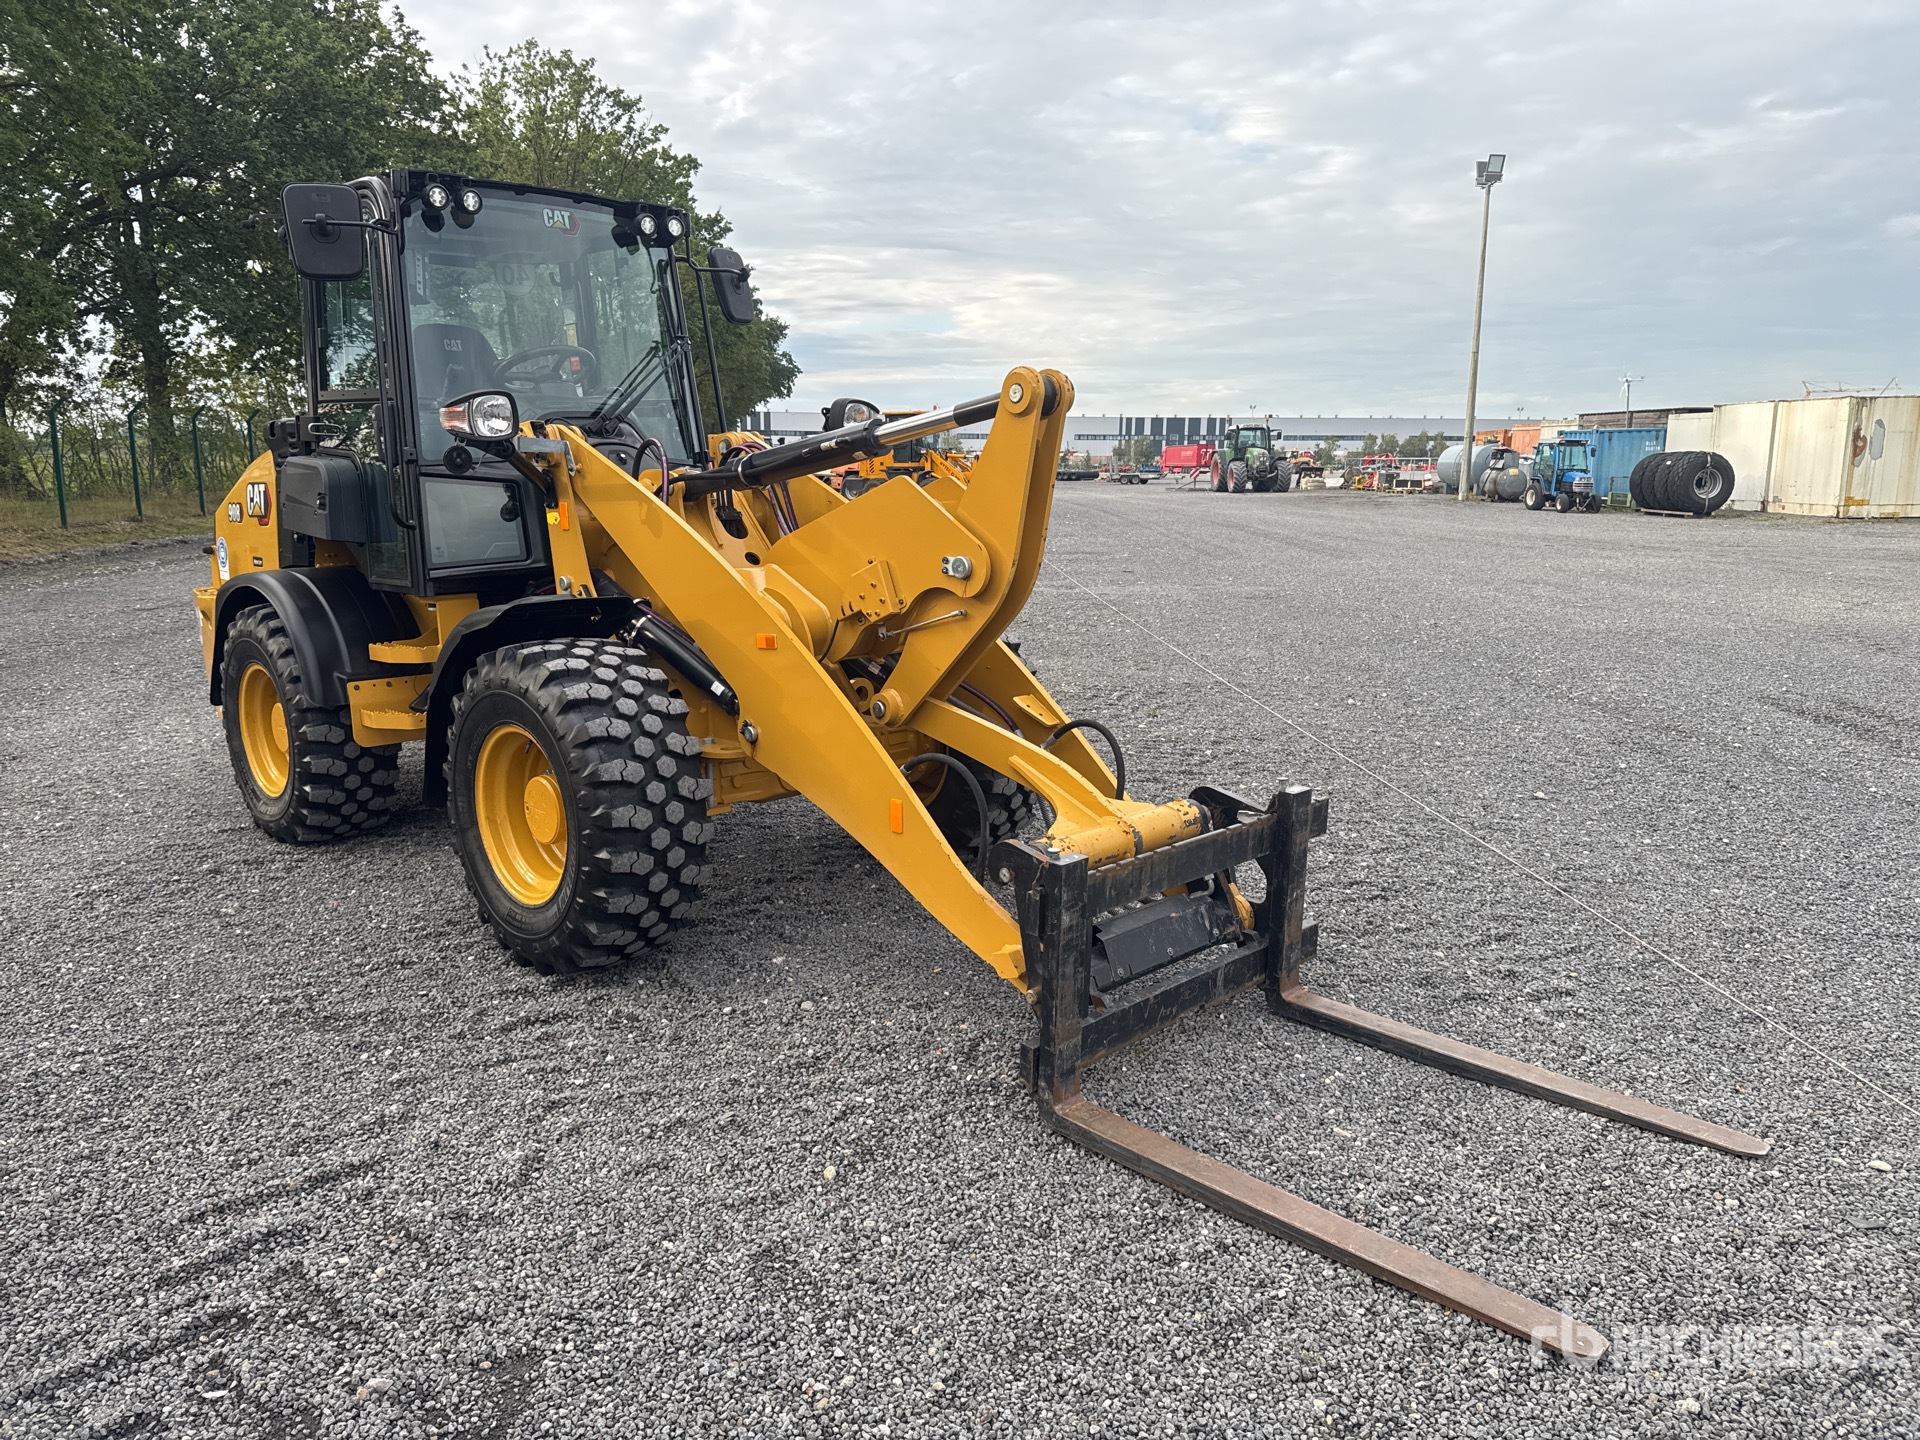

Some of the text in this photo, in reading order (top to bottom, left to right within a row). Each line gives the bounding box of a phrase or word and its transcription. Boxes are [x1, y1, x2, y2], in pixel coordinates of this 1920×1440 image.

[542, 208, 570, 230] CAT
[443, 339, 462, 351] CAT
[246, 483, 266, 517] CAT
[228, 503, 241, 523] 908
